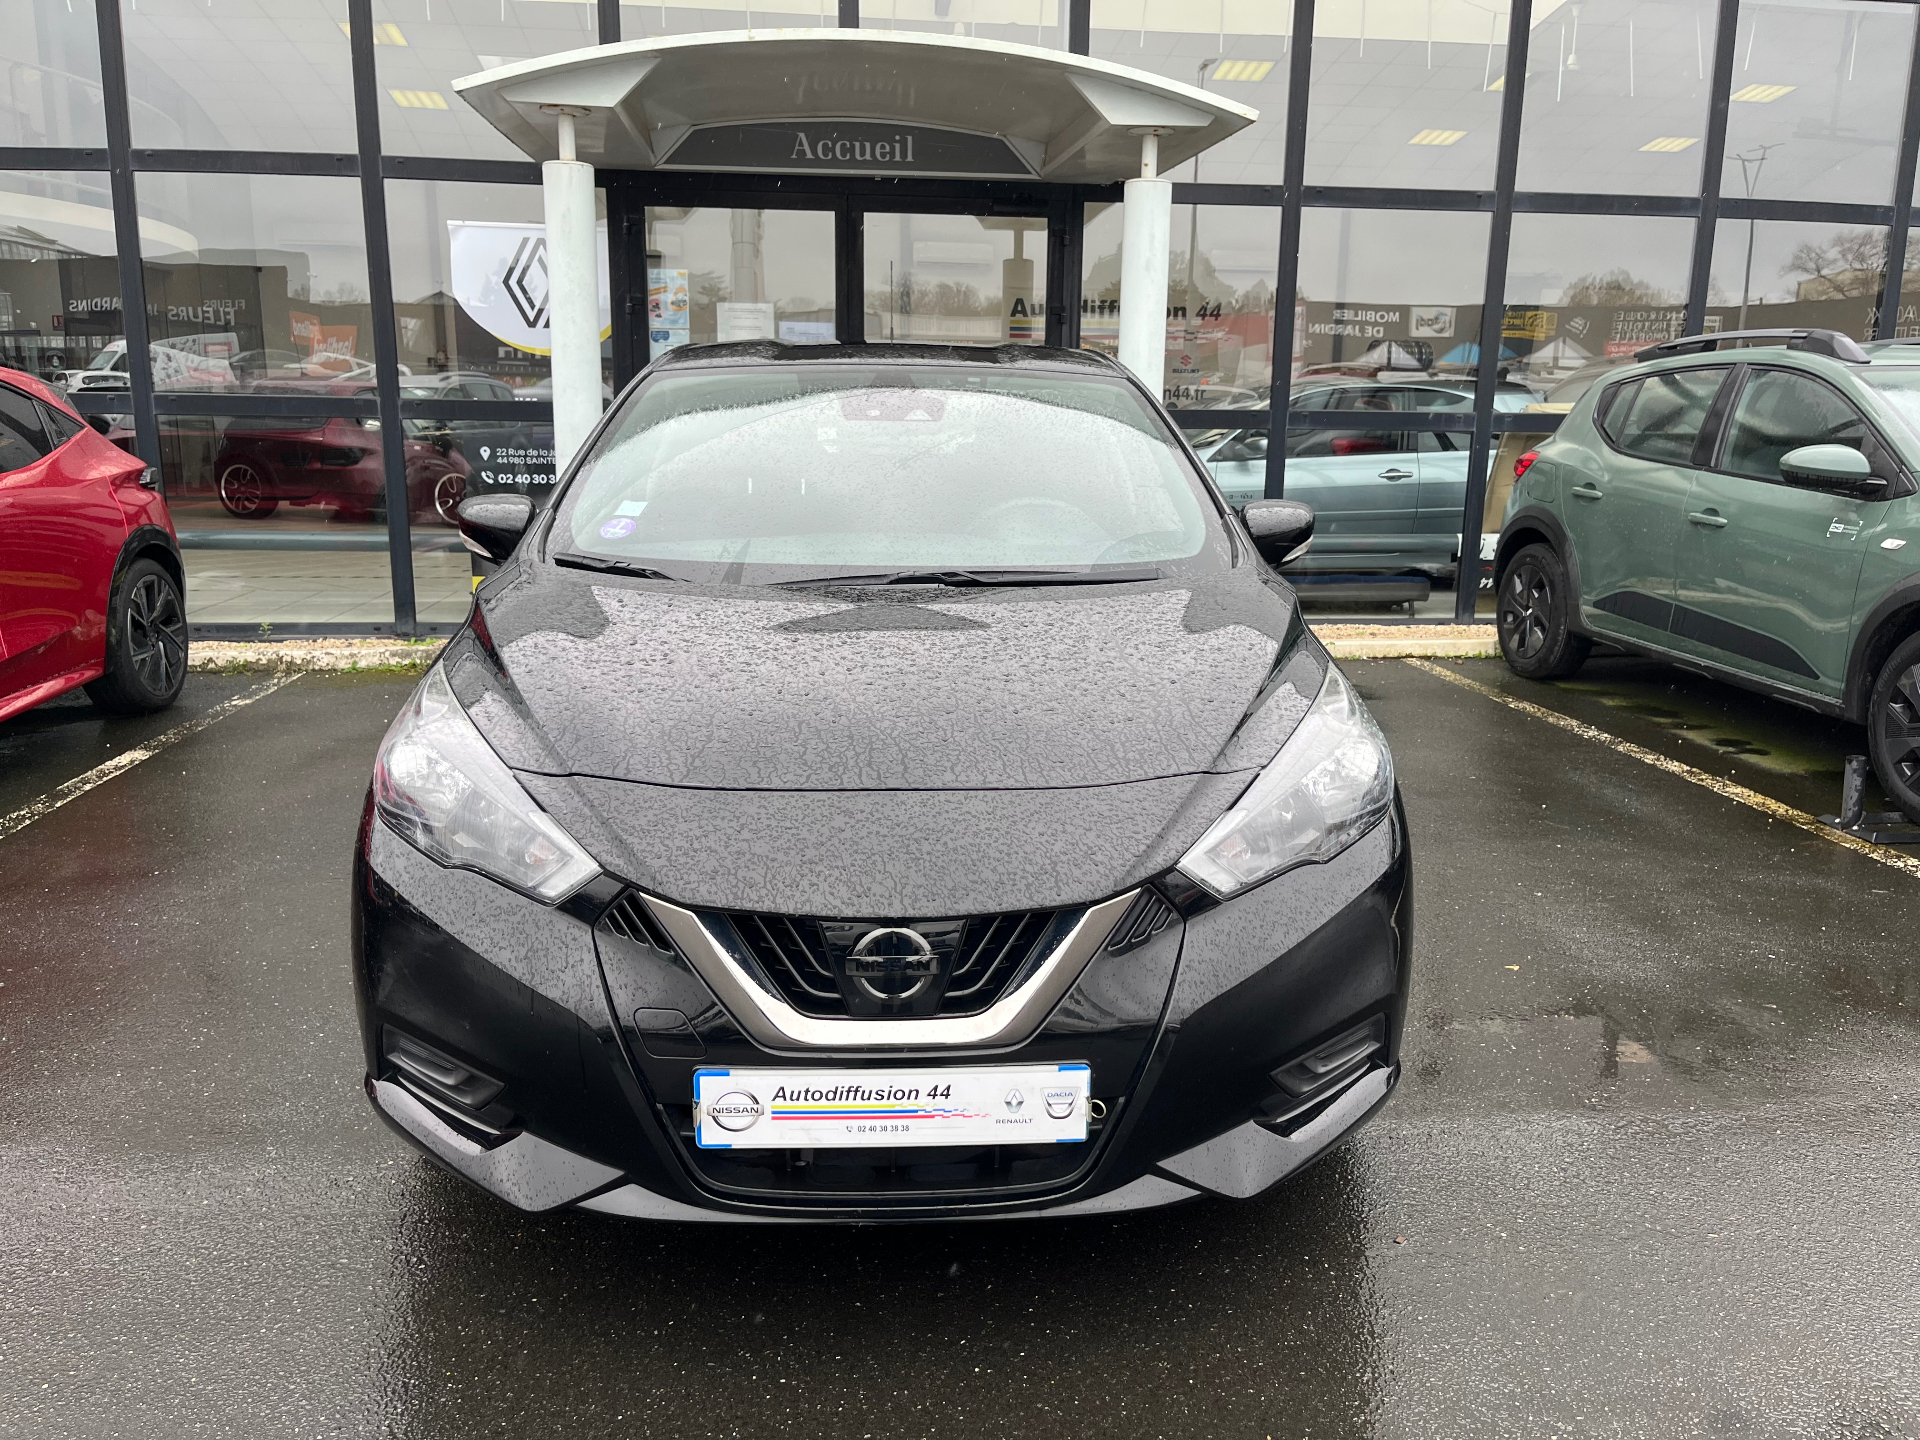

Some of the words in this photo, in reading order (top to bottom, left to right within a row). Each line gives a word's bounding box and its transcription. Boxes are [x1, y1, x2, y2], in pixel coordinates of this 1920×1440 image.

[790, 132, 915, 163] Accueil
[1195, 300, 1222, 322] 44
[496, 447, 508, 456] 22
[508, 448, 526, 456] Rue
[526, 448, 539, 457] de
[539, 448, 548, 457] la
[496, 456, 508, 464] 44
[508, 456, 525, 465] 980
[498, 473, 514, 484] 02
[514, 473, 531, 484] 40
[532, 473, 548, 484] 30
[855, 960, 931, 973] NISSAN
[771, 1085, 920, 1102] Autodiffusion
[926, 1084, 952, 1100] 44
[712, 1106, 759, 1114] NISSAN
[857, 1125, 867, 1133] 02
[868, 1125, 877, 1133] 40
[900, 1124, 910, 1132] 38
